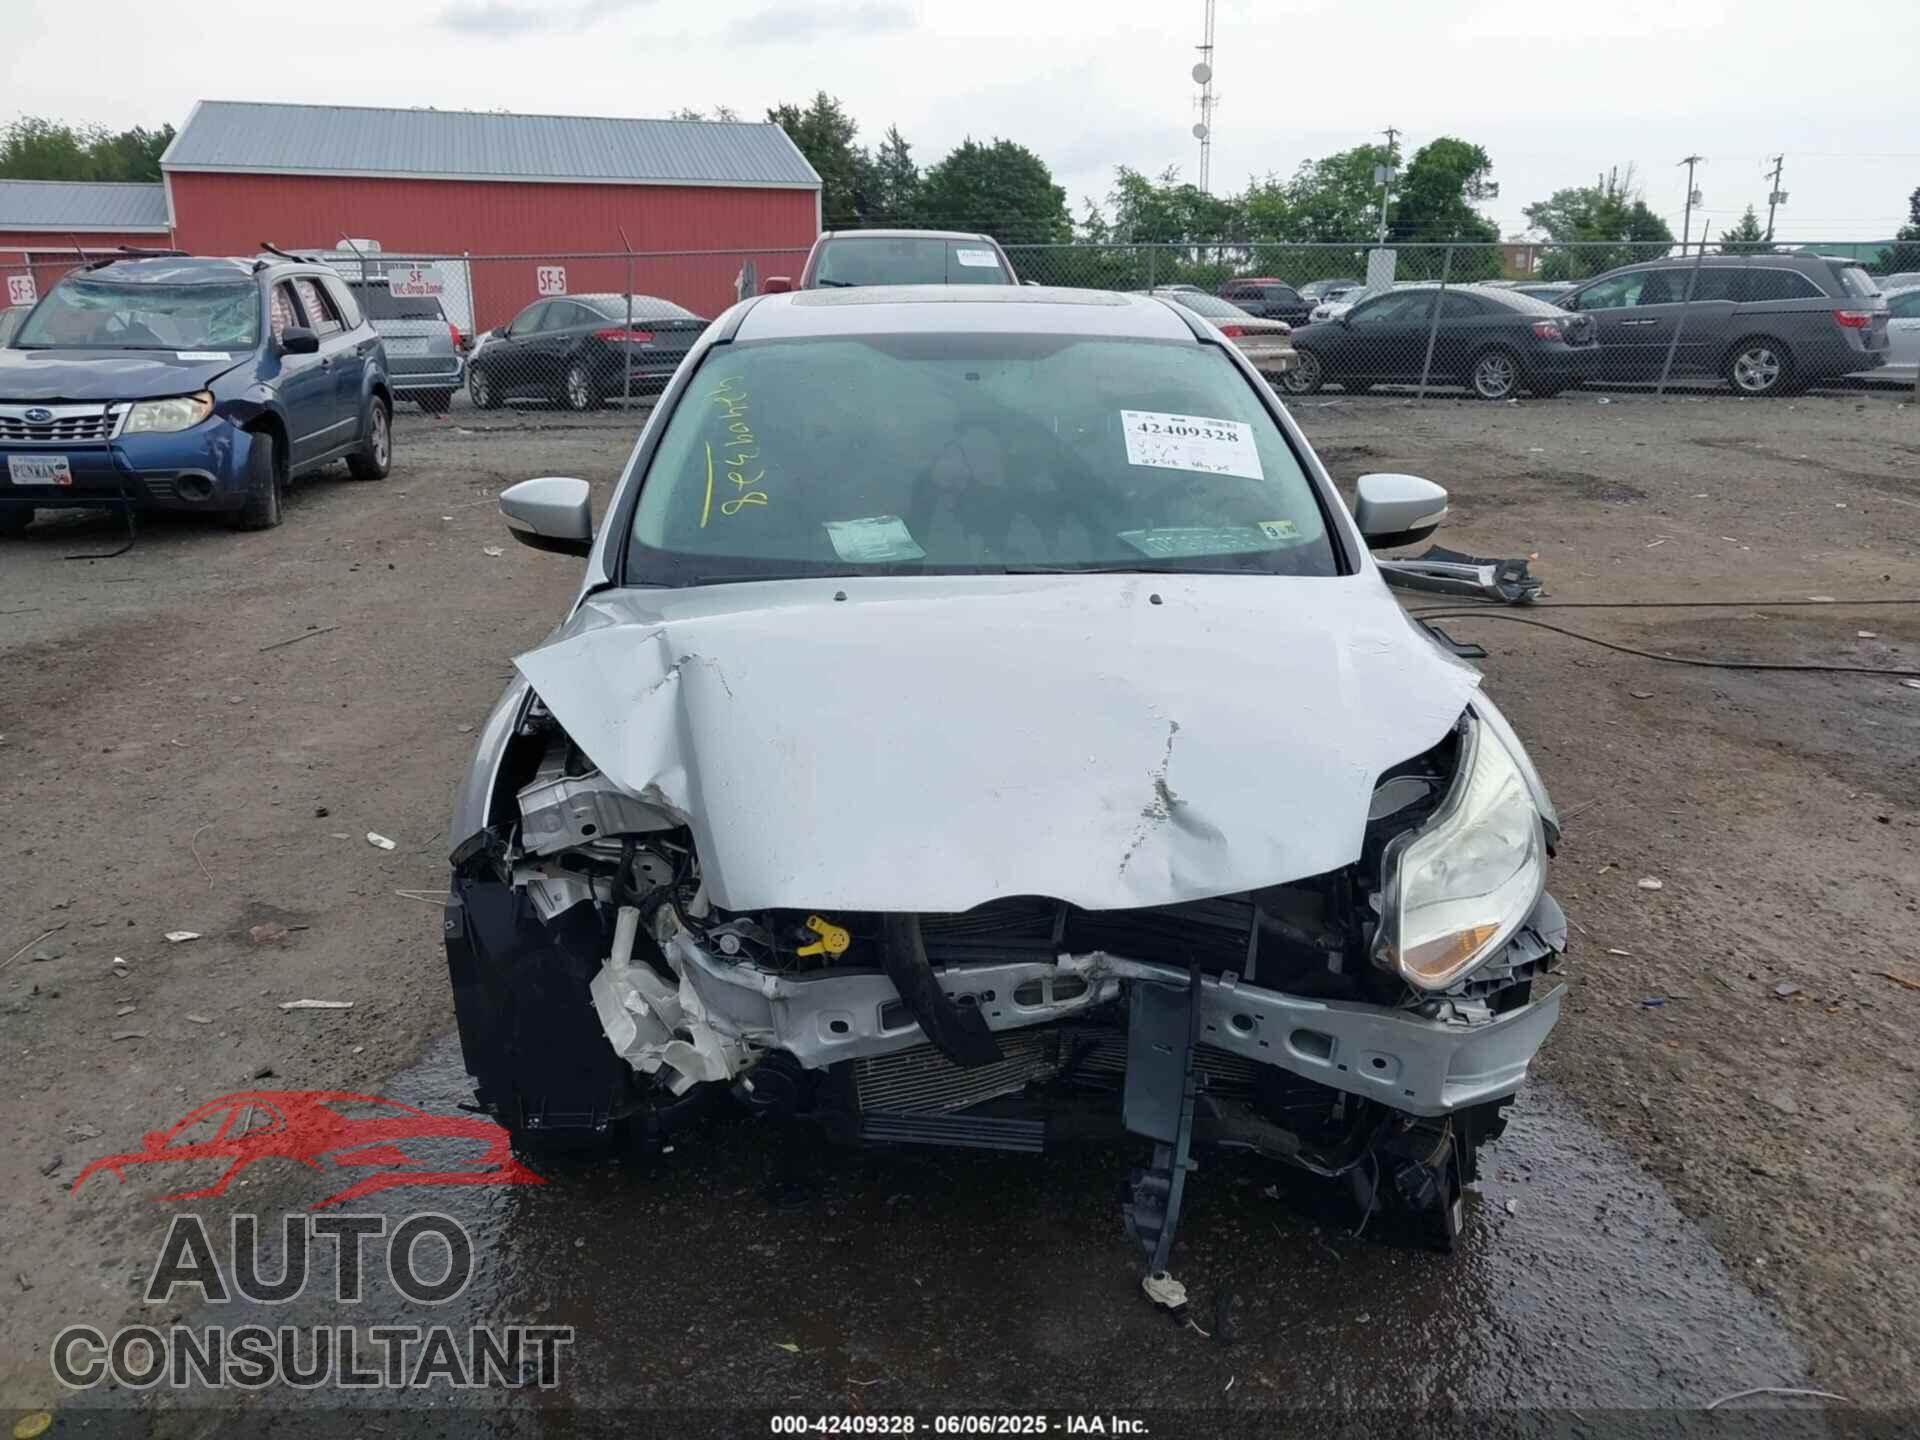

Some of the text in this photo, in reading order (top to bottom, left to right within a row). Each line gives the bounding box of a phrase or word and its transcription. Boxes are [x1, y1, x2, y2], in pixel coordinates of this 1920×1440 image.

[409, 270, 423, 282] SF
[540, 271, 566, 291] SF-5
[11, 279, 35, 300] SF-3
[426, 282, 443, 294] Zone
[1137, 422, 1240, 443] 42409328
